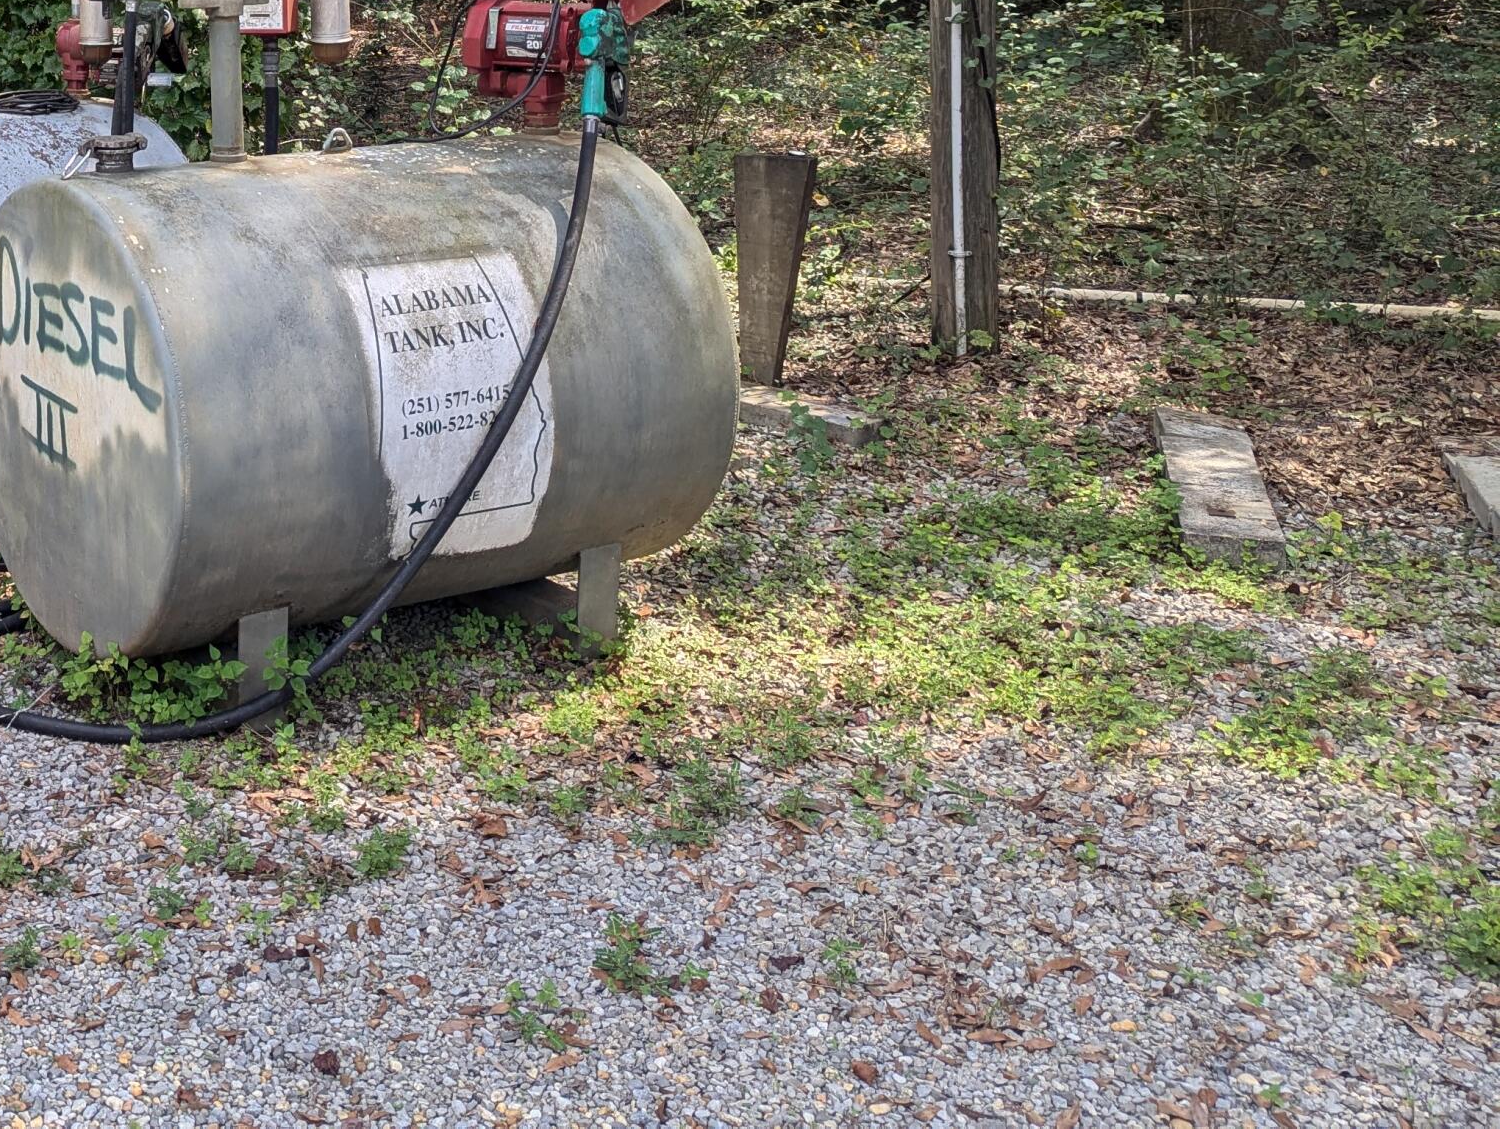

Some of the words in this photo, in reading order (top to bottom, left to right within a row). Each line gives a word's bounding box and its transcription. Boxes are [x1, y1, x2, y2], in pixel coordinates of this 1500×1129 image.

[381, 283, 492, 317] ALABAMA
[384, 324, 455, 353] TANK,
[456, 317, 504, 344] INC.
[402, 396, 440, 418] (251)
[445, 384, 510, 409] 577-6415
[20, 374, 78, 469] III
